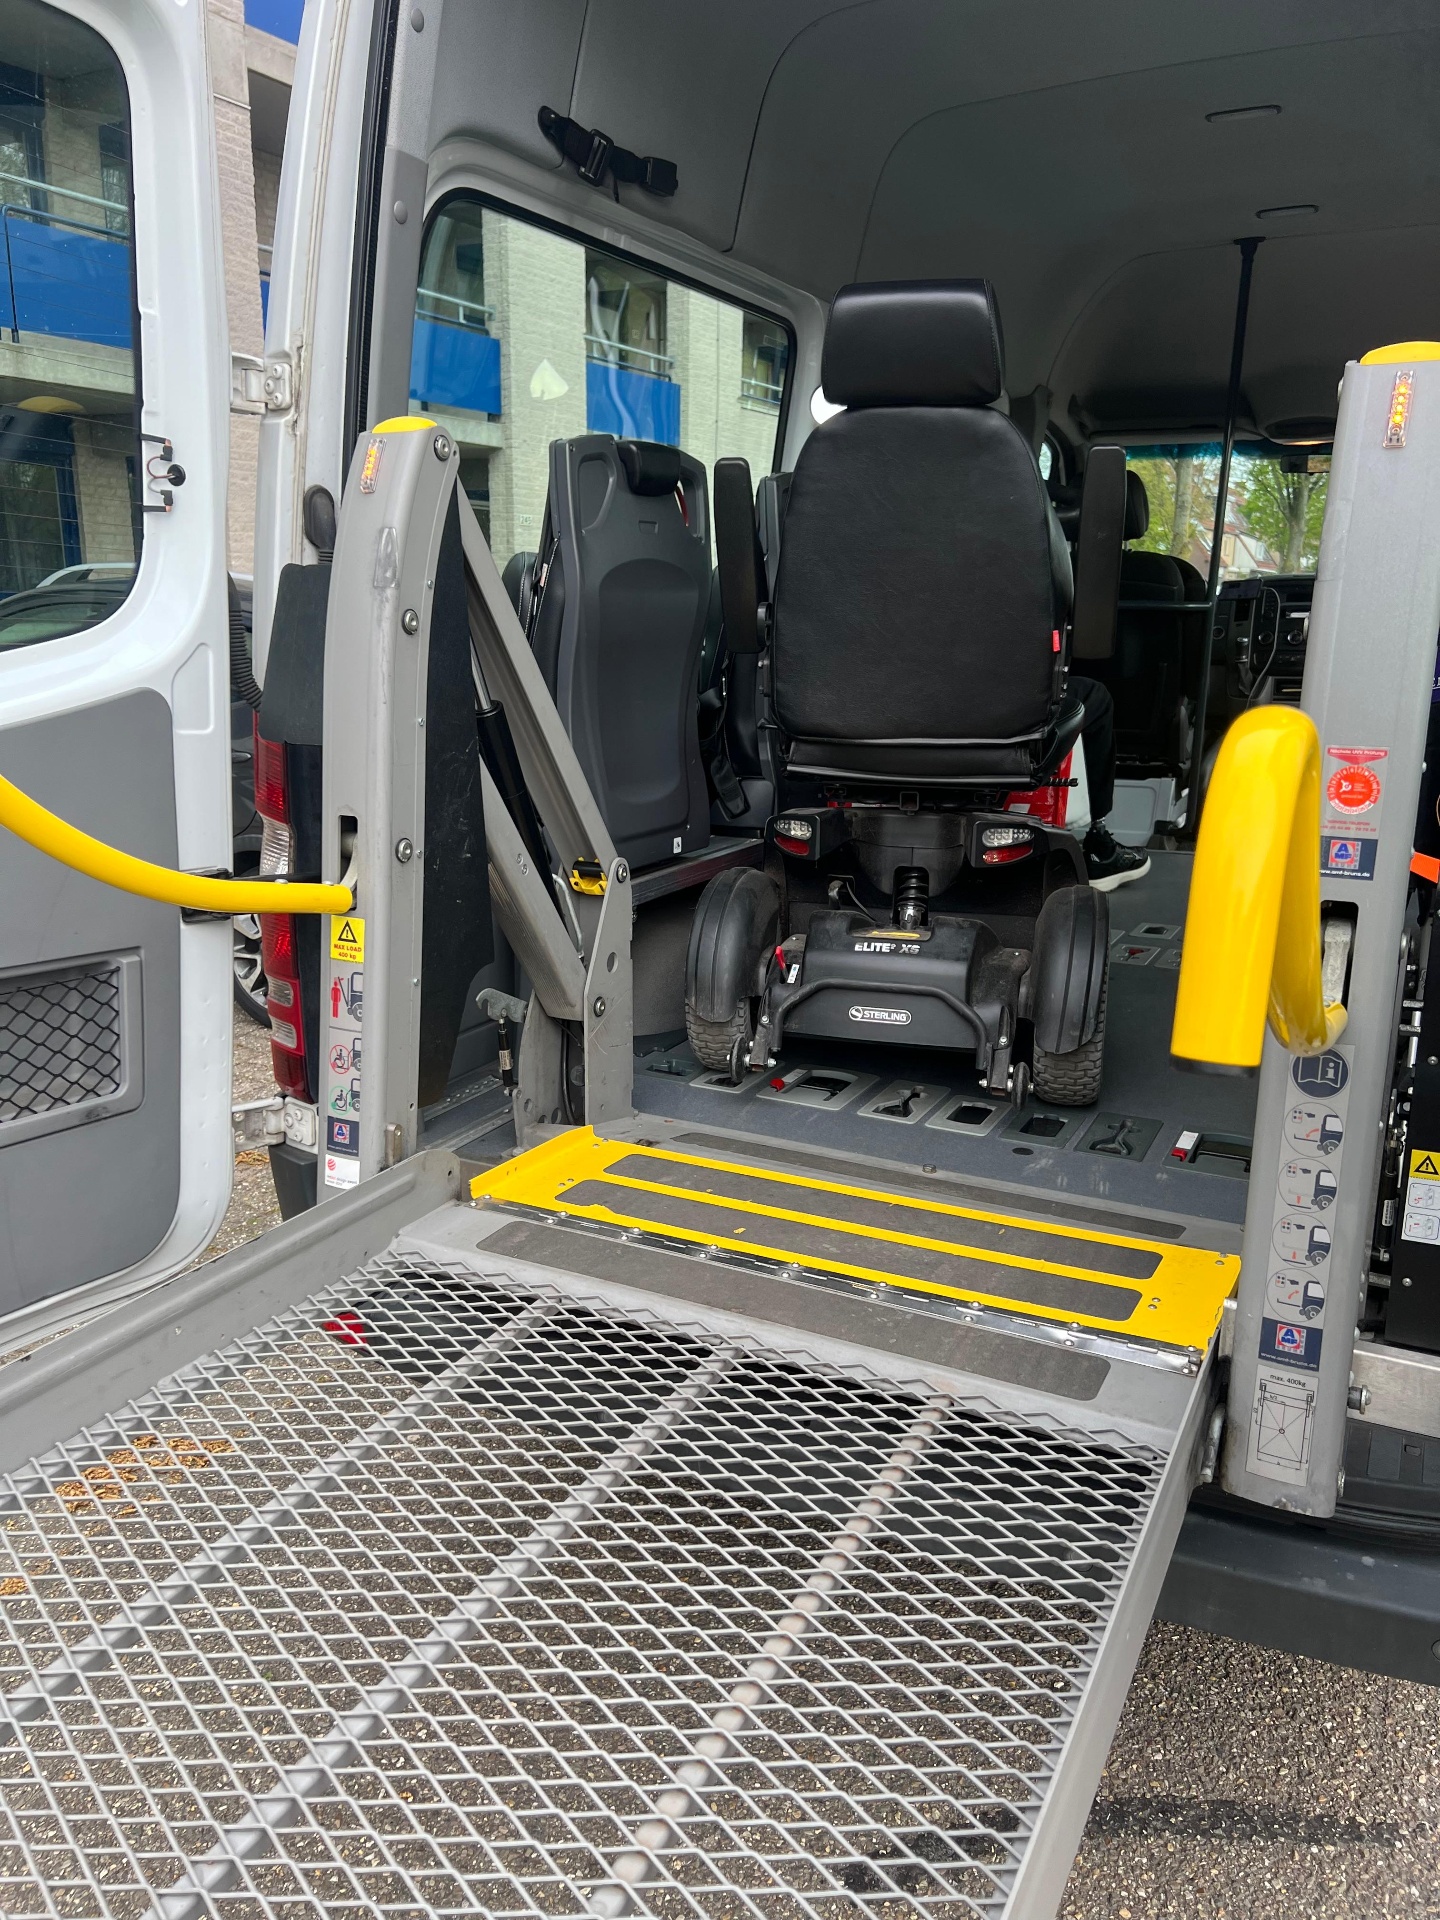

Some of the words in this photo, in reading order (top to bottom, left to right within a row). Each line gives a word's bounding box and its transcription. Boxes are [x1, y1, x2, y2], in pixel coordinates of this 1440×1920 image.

[899, 944, 920, 954] XS
[863, 1010, 907, 1021] STERLING
[1269, 1374, 1286, 1383] max.
[1286, 1377, 1307, 1388] 400kg
